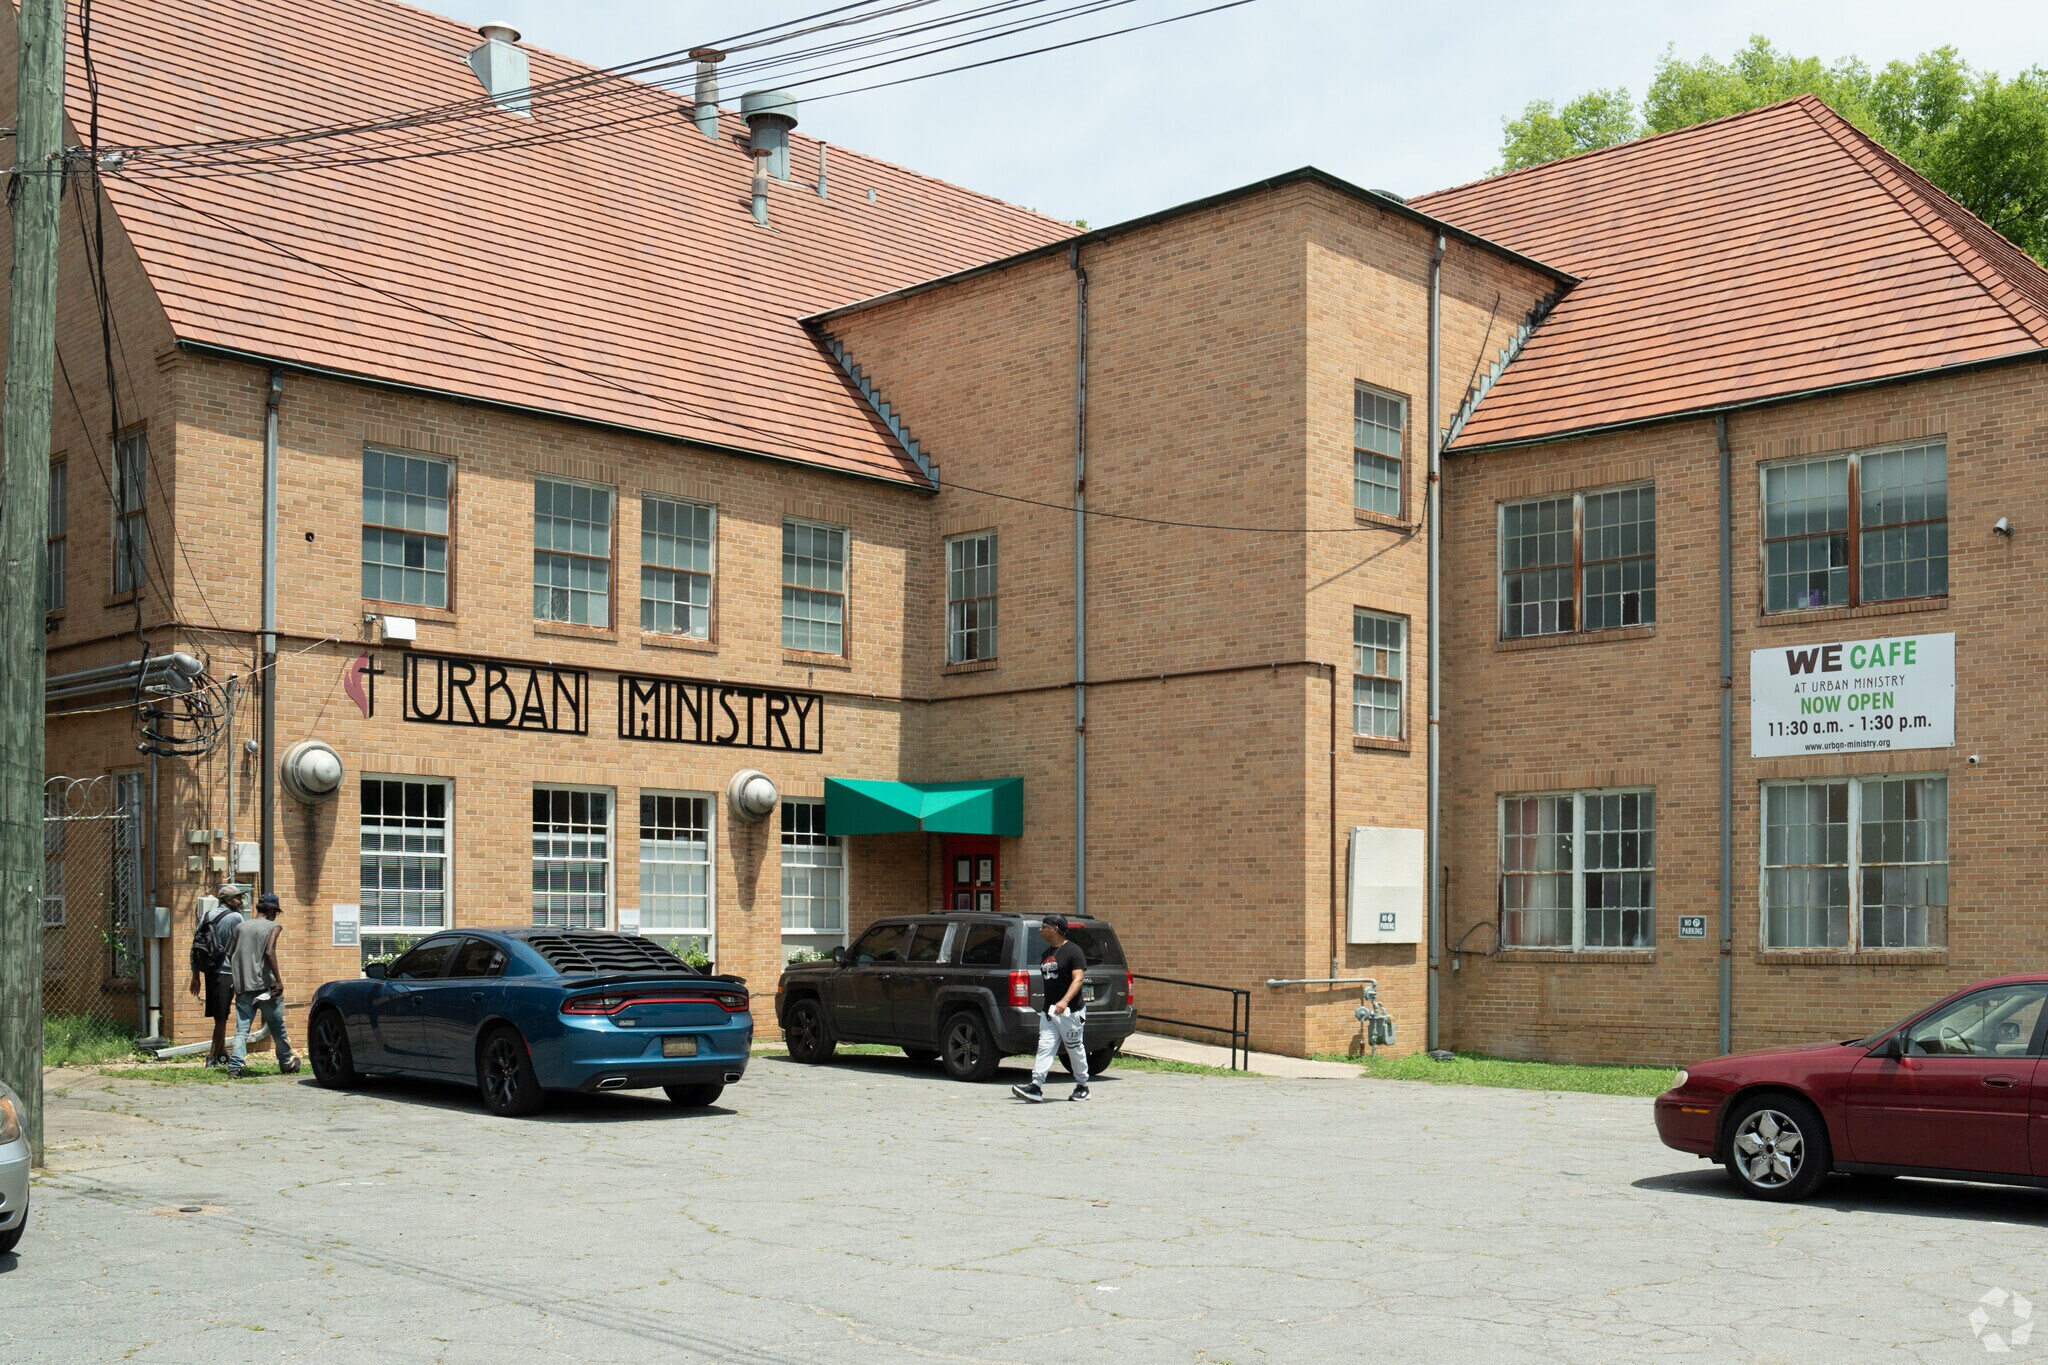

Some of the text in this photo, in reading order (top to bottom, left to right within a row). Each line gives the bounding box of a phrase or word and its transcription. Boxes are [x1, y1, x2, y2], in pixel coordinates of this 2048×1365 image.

[1786, 640, 1916, 676] WE CAFE
[1794, 674, 1905, 693] AT URBAN MINISTRY
[409, 653, 816, 751] URBAN MINISTRY
[1801, 691, 1894, 714] NOW OPEN
[1768, 720, 1808, 737] 11:30
[1813, 720, 1843, 734] a.m.
[1861, 714, 1894, 731] 1:30
[1899, 715, 1931, 732] p.m.
[1805, 739, 1890, 751] www.urban-ministry.org
[1681, 927, 1703, 935] PARKING
[1684, 918, 1692, 927] NO
